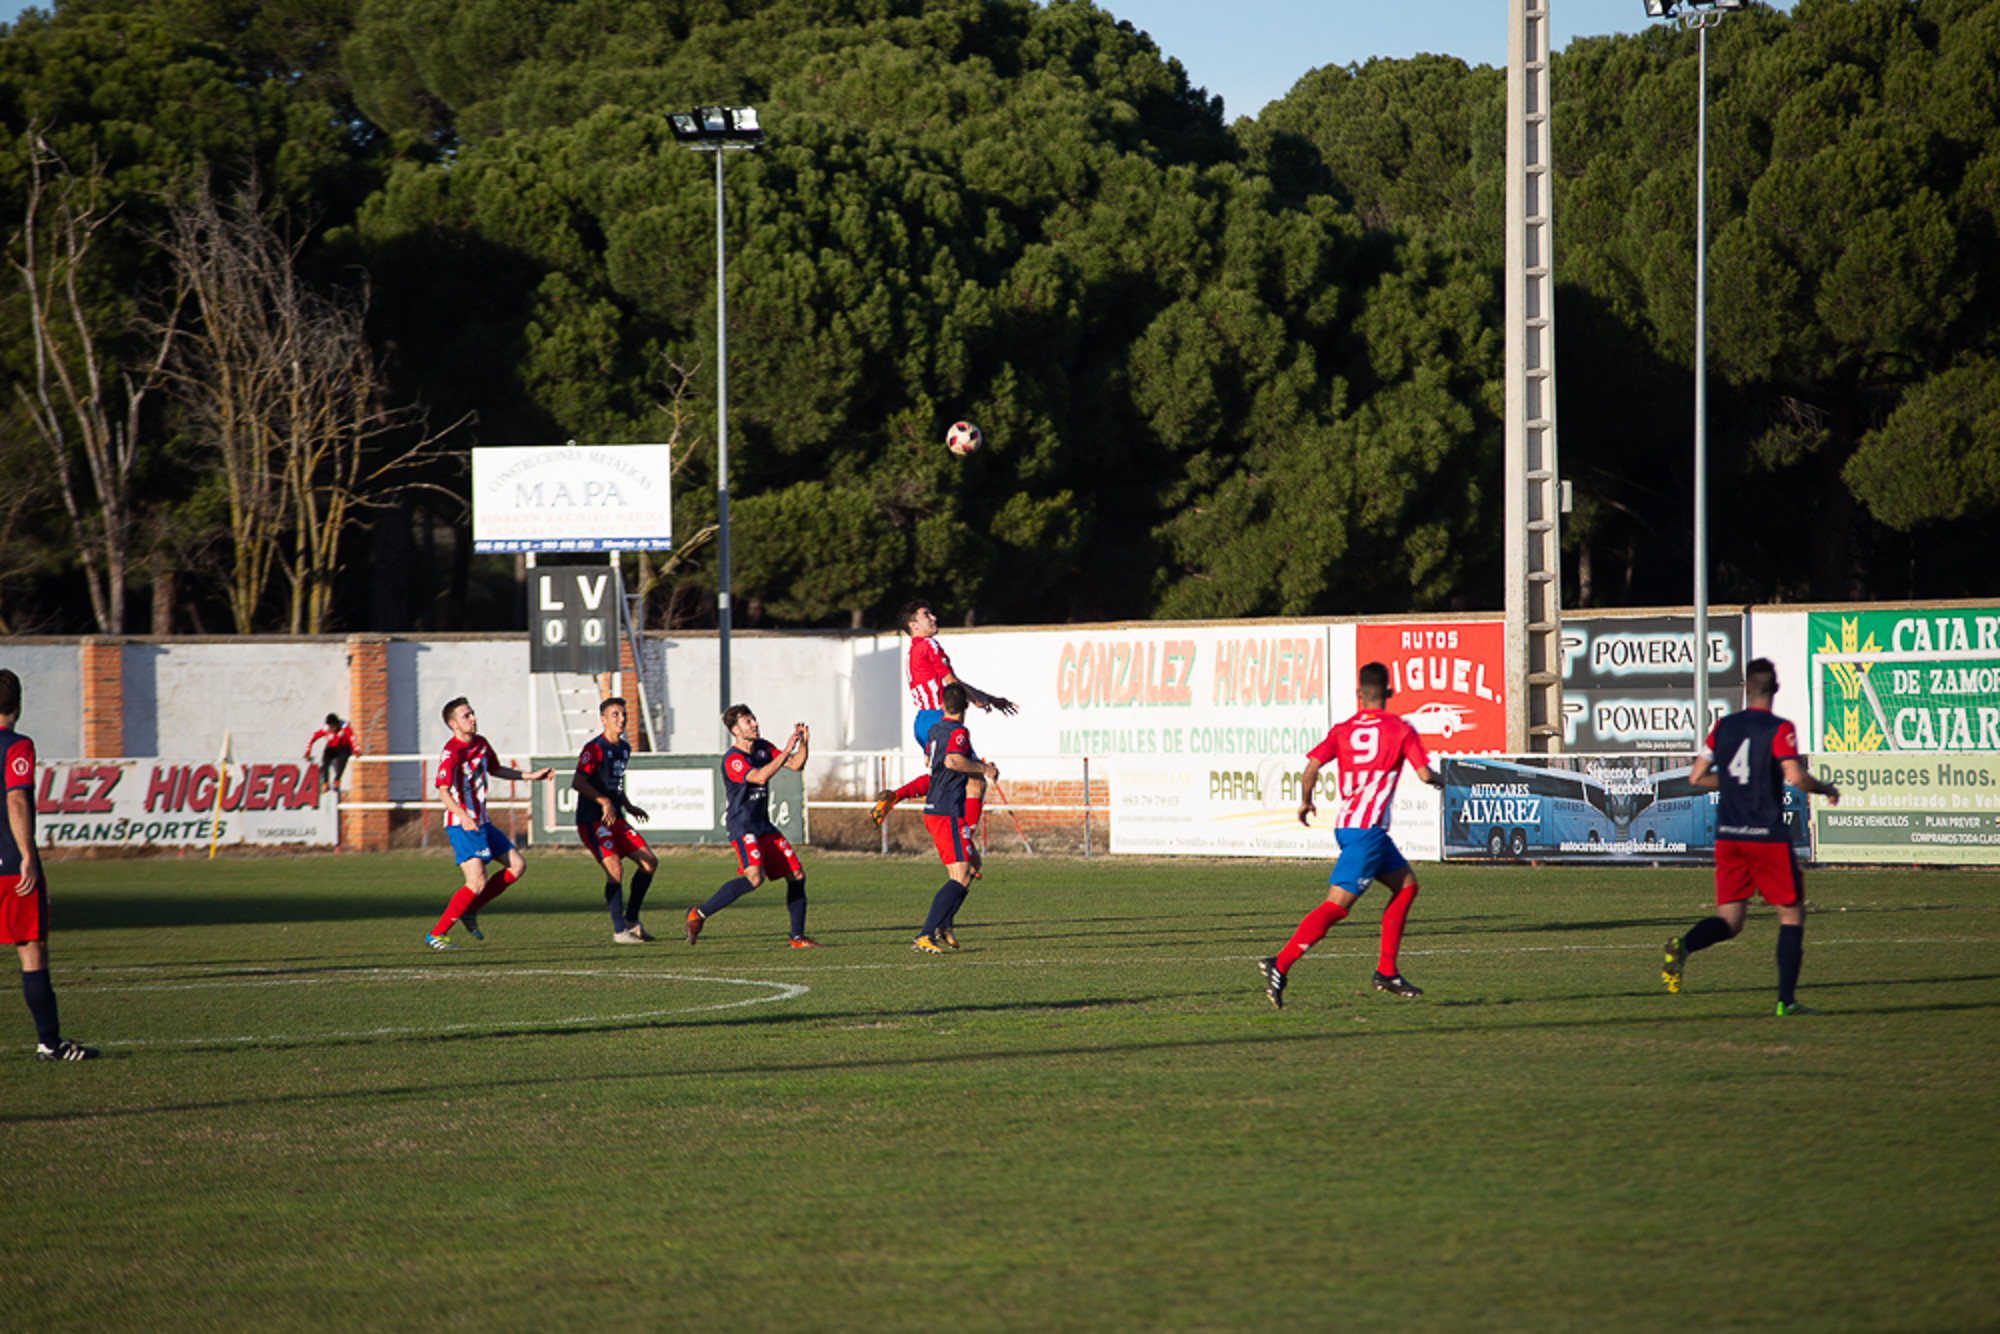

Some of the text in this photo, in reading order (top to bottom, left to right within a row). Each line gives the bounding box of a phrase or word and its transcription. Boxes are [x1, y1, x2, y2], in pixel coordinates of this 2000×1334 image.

[514, 481, 628, 508] MAPA
[540, 575, 608, 610] L V
[546, 618, 602, 643] 0 0
[1402, 631, 1458, 649] AUTOS
[1596, 639, 1723, 667] POWERAE
[1057, 637, 1324, 709] GONZALEZ HIGUERA
[1392, 657, 1502, 704] IGUEL.
[1893, 670, 1921, 694] DE
[1059, 729, 1156, 754] MATERIALES
[1163, 729, 1183, 753] DE
[1350, 727, 1379, 764] 9
[1636, 768, 1648, 778] en
[1728, 737, 1750, 785] 4
[36, 764, 320, 814] LEZ HIGUERA
[1604, 779, 1654, 795] Facebook
[1819, 764, 1996, 791] Desguaces Hnos.
[1470, 783, 1529, 798] AUTOCARES
[1820, 793, 1864, 808] Ctro
[1870, 792, 1946, 808] Autorizado
[1952, 793, 1969, 808] De
[1460, 800, 1541, 823] ALVAREZ
[1828, 815, 1852, 827] BAJAS
[1925, 816, 1980, 828] PLAN PREVER
[44, 821, 226, 842] TRANSPORTES
